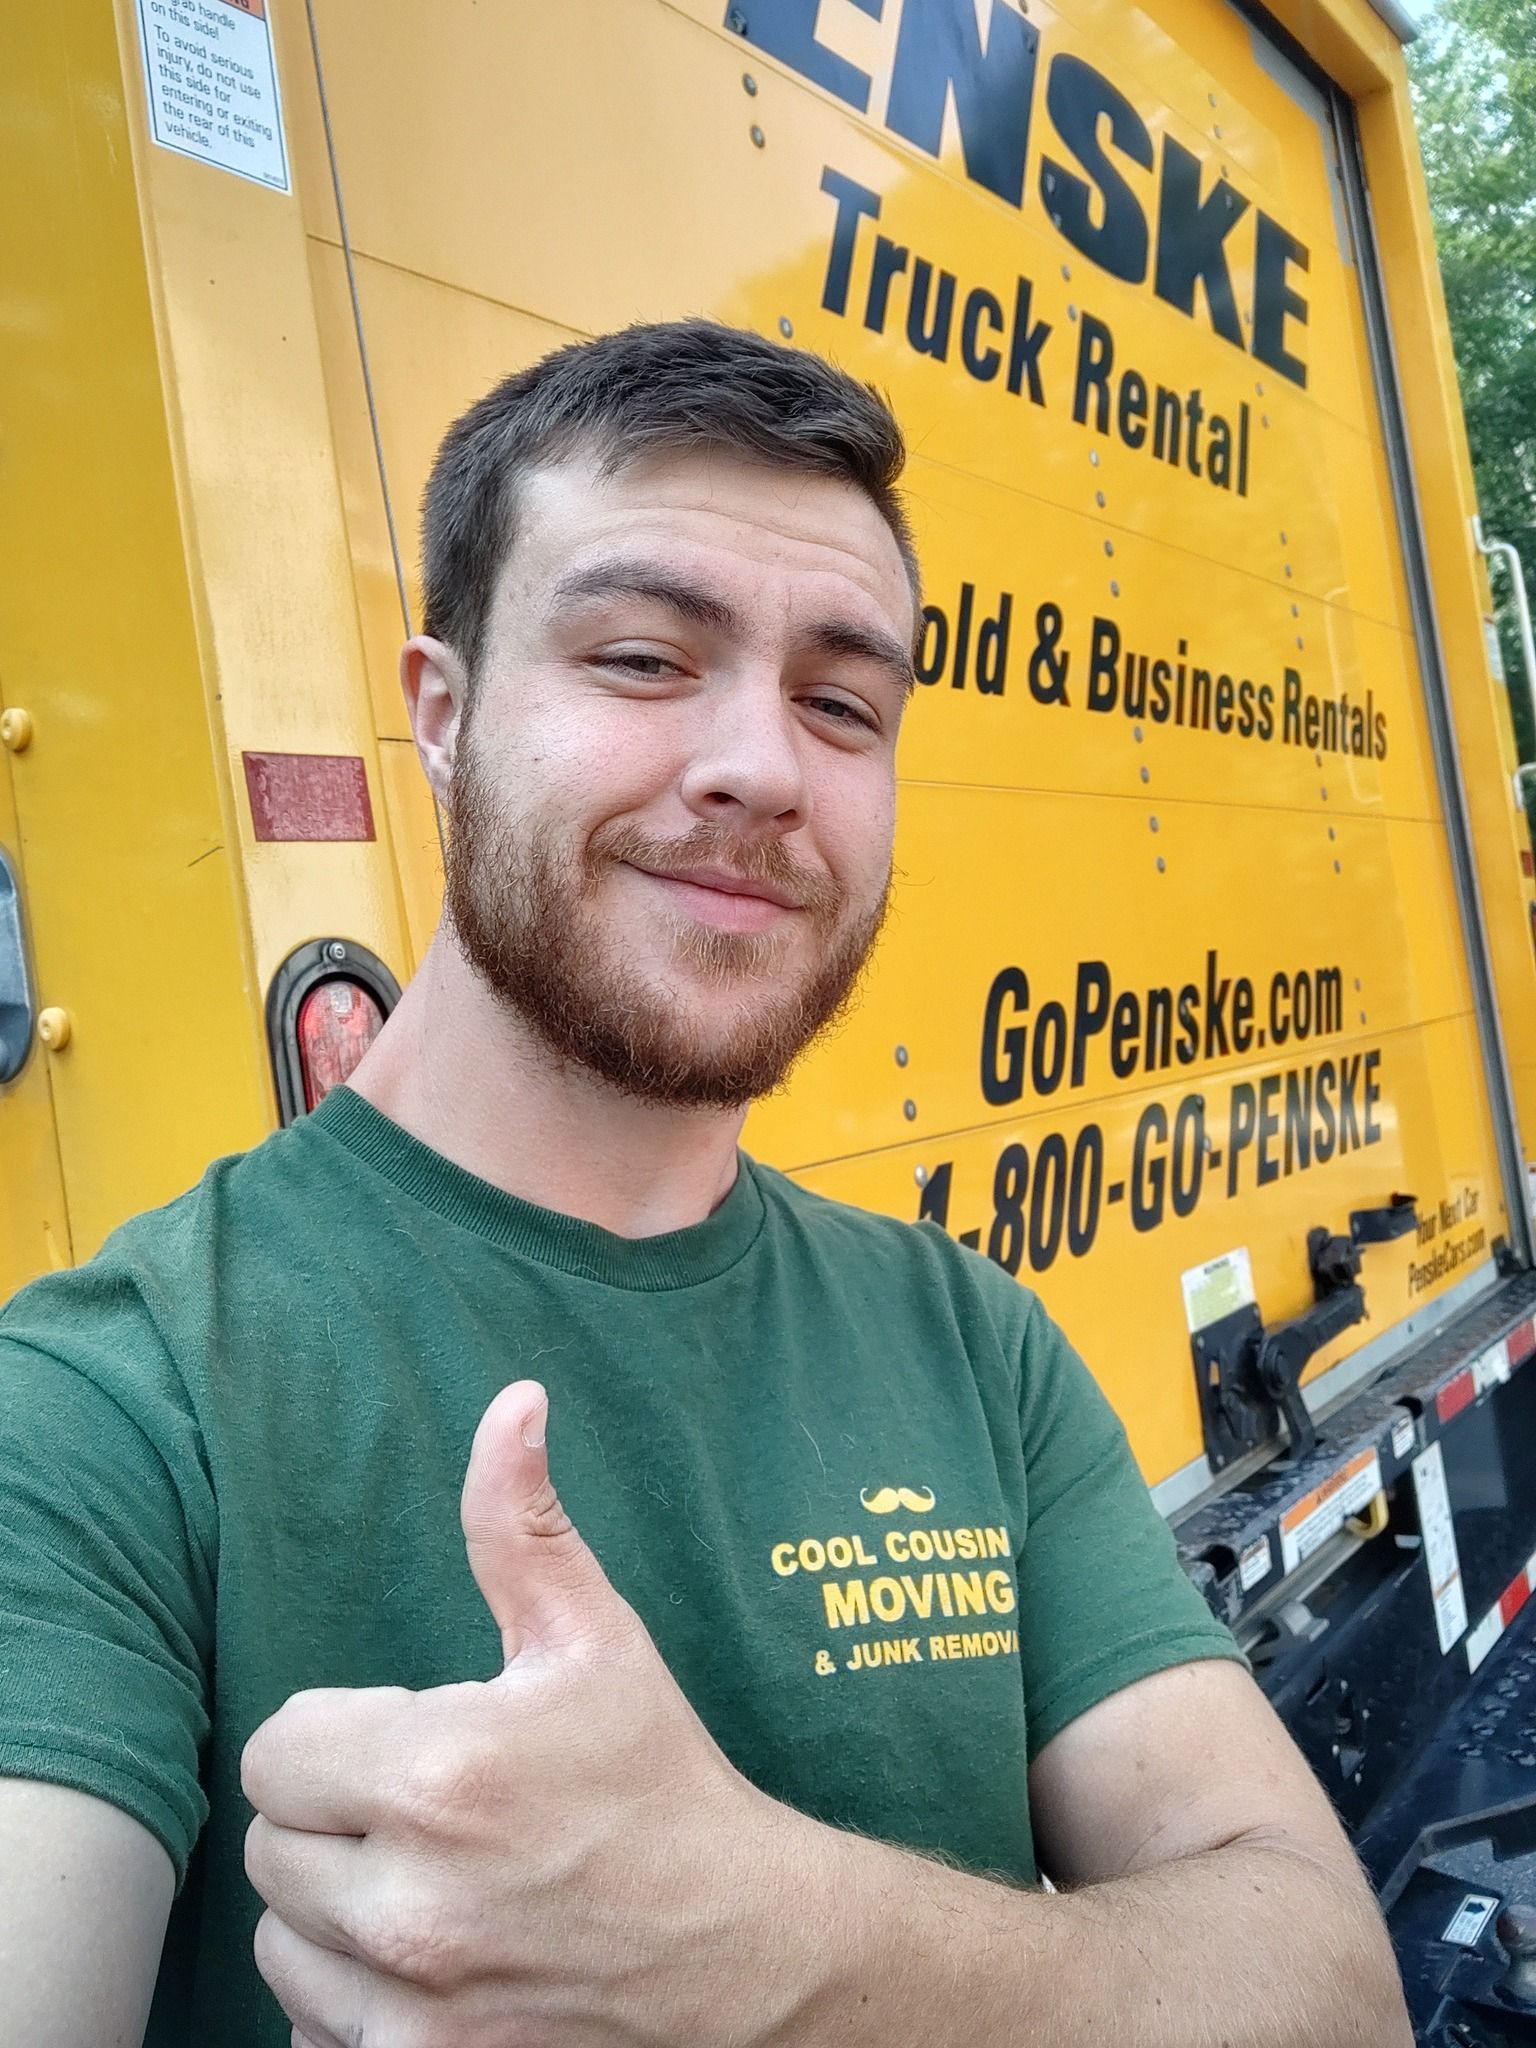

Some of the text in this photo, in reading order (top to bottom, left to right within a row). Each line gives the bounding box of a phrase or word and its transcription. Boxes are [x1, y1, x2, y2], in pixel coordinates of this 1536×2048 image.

[151, 1, 166, 16] on
[168, 7, 190, 27] this
[199, 2, 236, 31] handle
[153, 24, 254, 79] To avoid serious
[157, 43, 261, 99] injury, do not use
[159, 64, 232, 103] this side for
[162, 85, 272, 141] entering or exiting
[163, 101, 255, 147] the rear of this
[165, 121, 213, 148] vehicle.
[819, 163, 1250, 499] Truck Rental
[913, 581, 1388, 762] old & Business Rentals
[979, 949, 1344, 1108] GoPenske.com
[771, 1526, 1012, 1577] COOL COUSIN
[822, 1570, 1017, 1629] MOVING
[815, 1649, 837, 1676] &
[846, 1638, 924, 1671] JUNK
